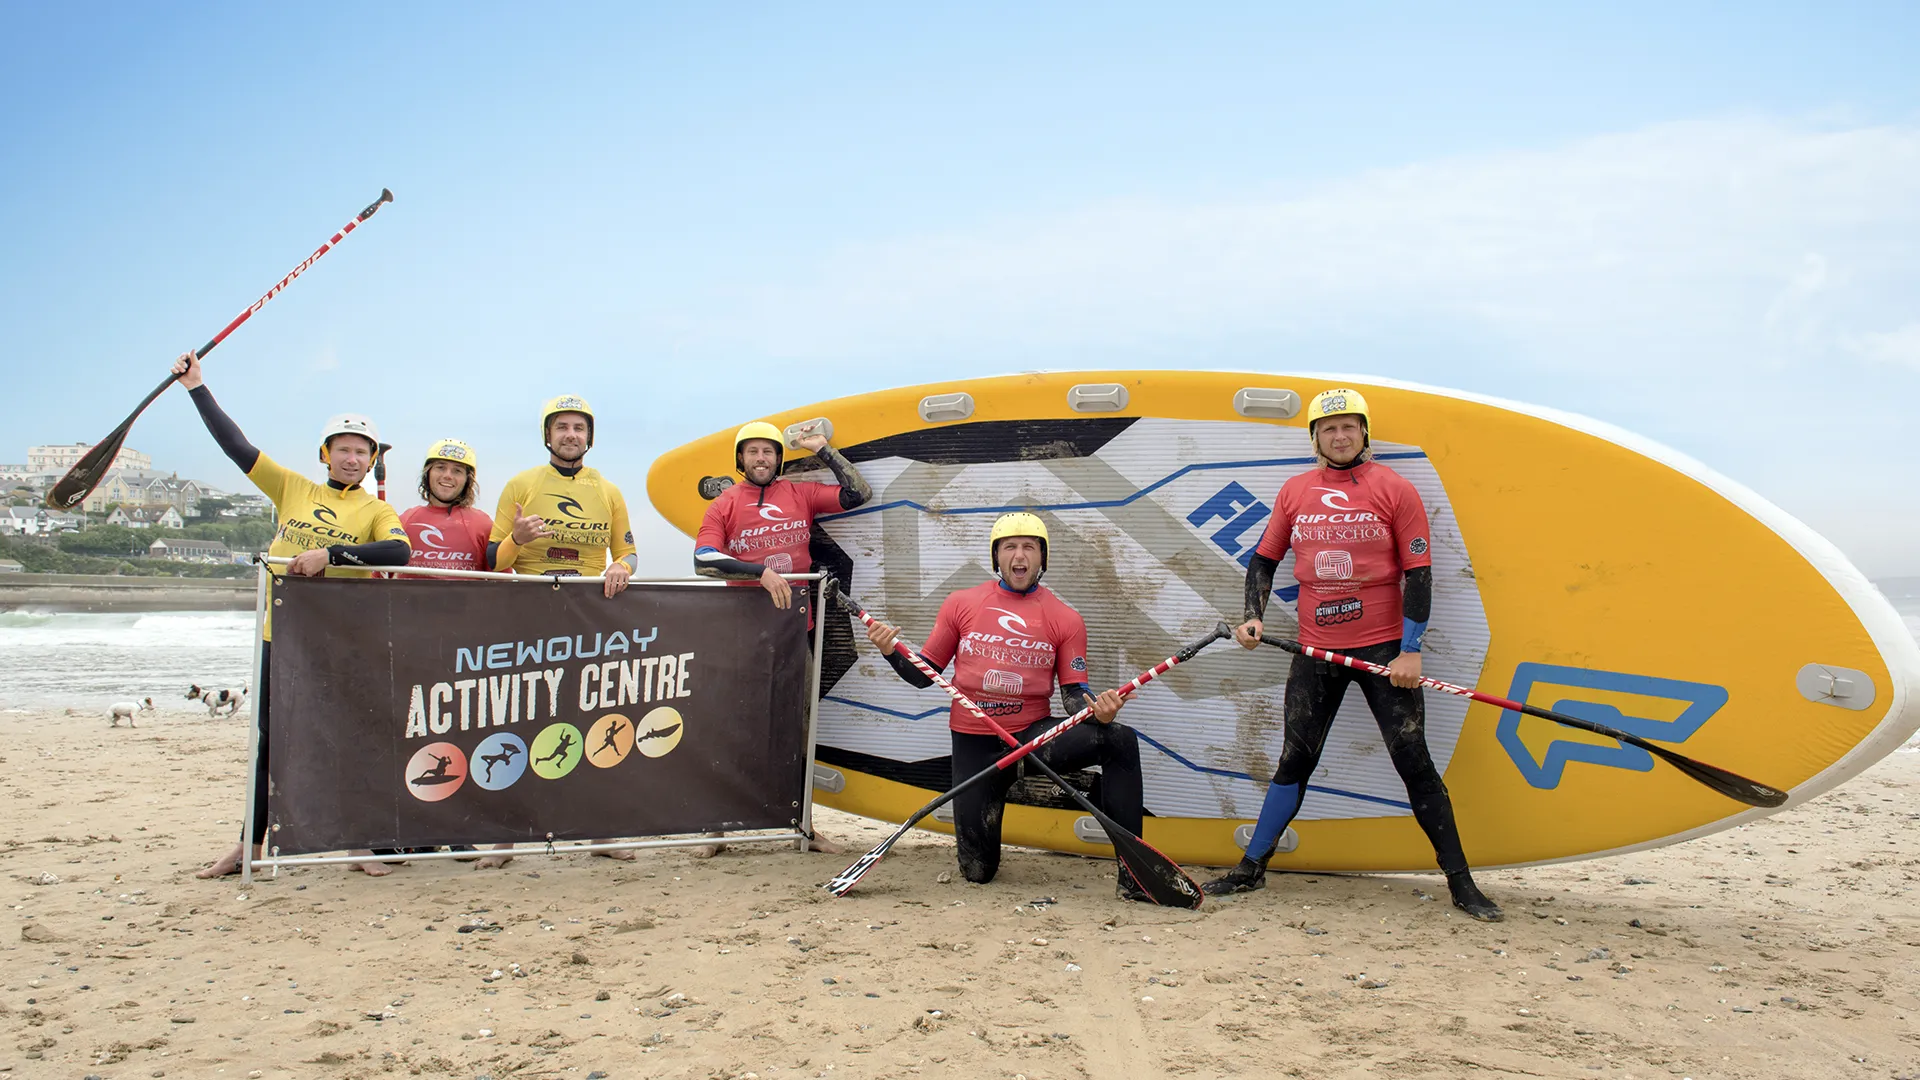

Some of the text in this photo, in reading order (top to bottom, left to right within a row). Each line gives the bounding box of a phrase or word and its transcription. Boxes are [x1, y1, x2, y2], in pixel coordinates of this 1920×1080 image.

[541, 517, 610, 531] IP CURL
[1296, 512, 1382, 524] RIP CURL
[287, 518, 312, 530] RIP
[312, 526, 360, 545] CURL
[740, 526, 770, 538] RIP
[771, 519, 808, 532] CURL
[1303, 530, 1334, 541] SURF
[570, 534, 610, 545] SCHOO
[750, 538, 777, 551] SURF
[778, 532, 811, 546] SCHOO
[423, 551, 474, 561] CURL
[1316, 601, 1362, 616] ACTIVITY CENTRE
[455, 626, 658, 673] NEWQUAY
[967, 632, 1055, 652] RIP CURL
[974, 647, 1009, 661] SURF
[1010, 654, 1056, 666] SCHOO
[405, 652, 695, 738] ACTIVITY CENTRE
